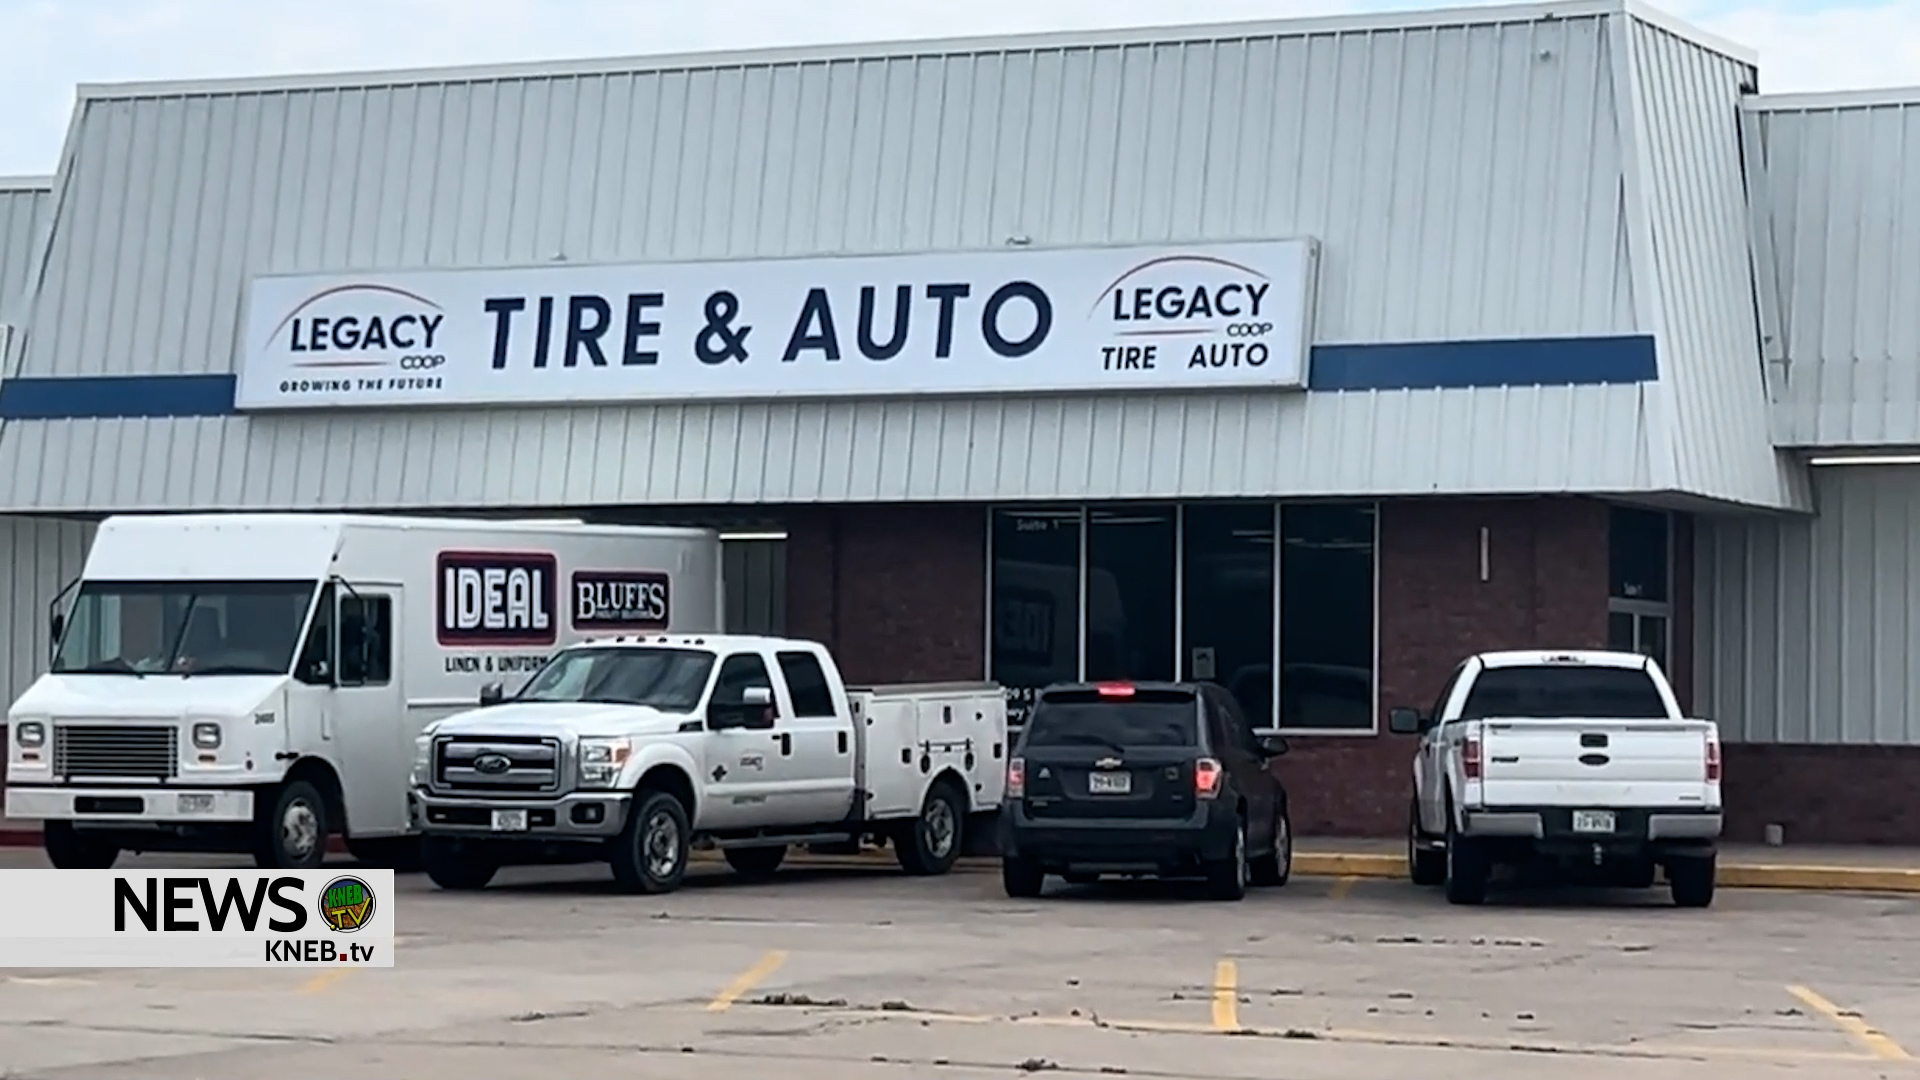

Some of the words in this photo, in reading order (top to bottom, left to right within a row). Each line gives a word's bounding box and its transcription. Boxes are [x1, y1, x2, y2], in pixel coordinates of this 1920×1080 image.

[1113, 283, 1269, 320] LEGACY
[290, 314, 444, 351] LEGACY
[484, 292, 664, 370] TIRE
[694, 290, 752, 365] &
[781, 279, 1053, 362] AUTO
[1226, 322, 1273, 338] COOP
[400, 354, 446, 370] COOP
[1101, 345, 1157, 370] TIRE
[1187, 342, 1269, 369] AUTO
[279, 380, 351, 393] GROWING
[358, 379, 384, 391] THE
[389, 377, 443, 390] FUTURE
[1016, 519, 1048, 531] Suite
[445, 567, 549, 629] IDEAL
[577, 582, 665, 620] BLUFFS
[445, 656, 480, 673] LINEN
[485, 655, 494, 673] &
